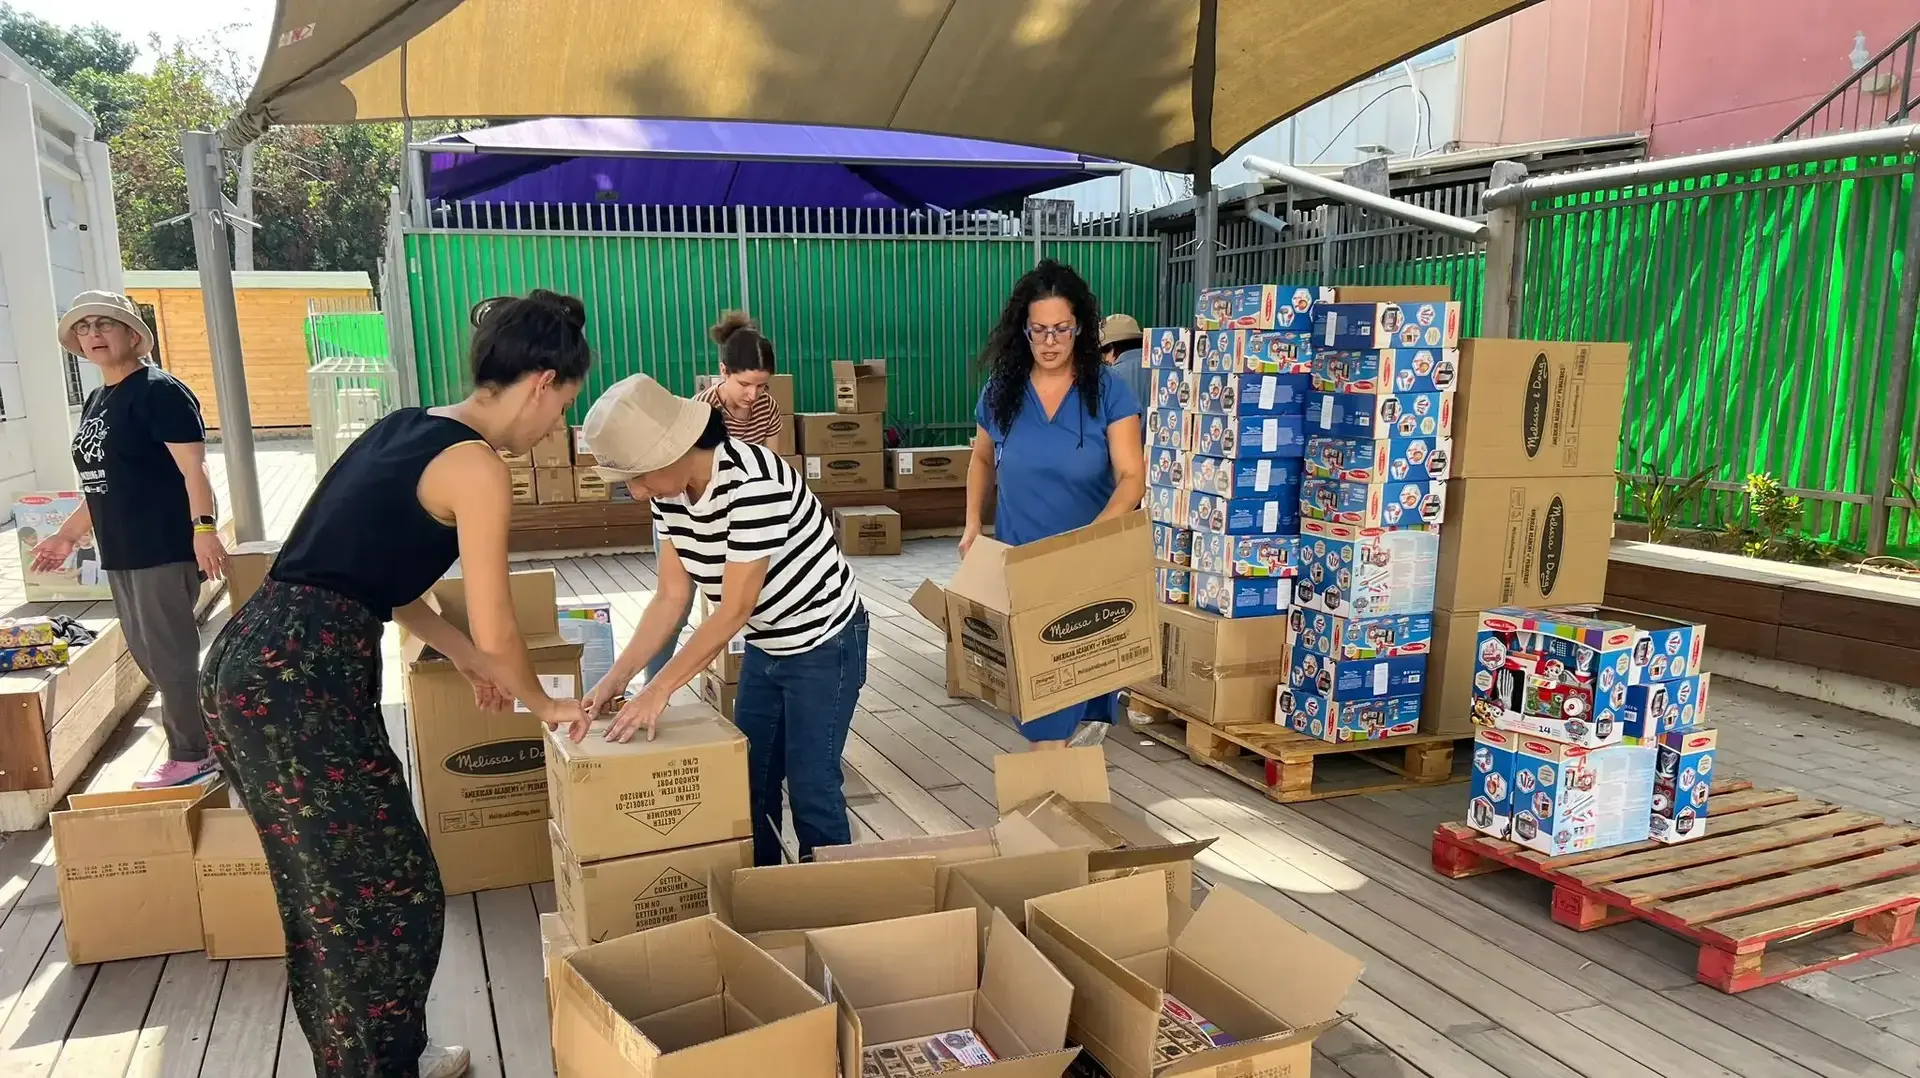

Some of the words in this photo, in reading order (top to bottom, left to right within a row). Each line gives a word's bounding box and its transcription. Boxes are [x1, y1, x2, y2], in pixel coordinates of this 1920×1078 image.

[1533, 362, 1547, 389] Doug
[1527, 402, 1541, 448] Melissa
[1549, 506, 1562, 550] Melissa
[1541, 562, 1555, 588] Doug
[1049, 618, 1091, 638] Melissa
[1102, 607, 1127, 623] Doug
[1053, 650, 1076, 662] AMERICAN
[1076, 643, 1096, 655] ACADEMY
[1101, 633, 1127, 646] PEDIATRICS
[1538, 725, 1551, 734] 14
[456, 754, 514, 771] Melissa
[519, 750, 526, 760] &
[530, 747, 546, 758] Do
[652, 769, 672, 779] CHINA
[673, 768, 681, 776] IN
[682, 766, 699, 775] MADE
[657, 778, 674, 787] PORT
[677, 784, 700, 792] GETTER
[464, 788, 493, 799] AMERICAN
[494, 785, 519, 795] ACADEMY
[527, 781, 548, 791] PEDIAT
[685, 792, 700, 801] ITEM
[646, 808, 682, 820] CONSUMER
[652, 817, 676, 827] GETTER
[659, 875, 682, 885] GETTER
[654, 882, 688, 894] CONSUMER
[635, 901, 650, 910] ITEM
[680, 891, 708, 903] 81280E12
[635, 909, 658, 919] GETTER
[680, 900, 708, 912] YFAR8128
[662, 913, 678, 924] PORT
